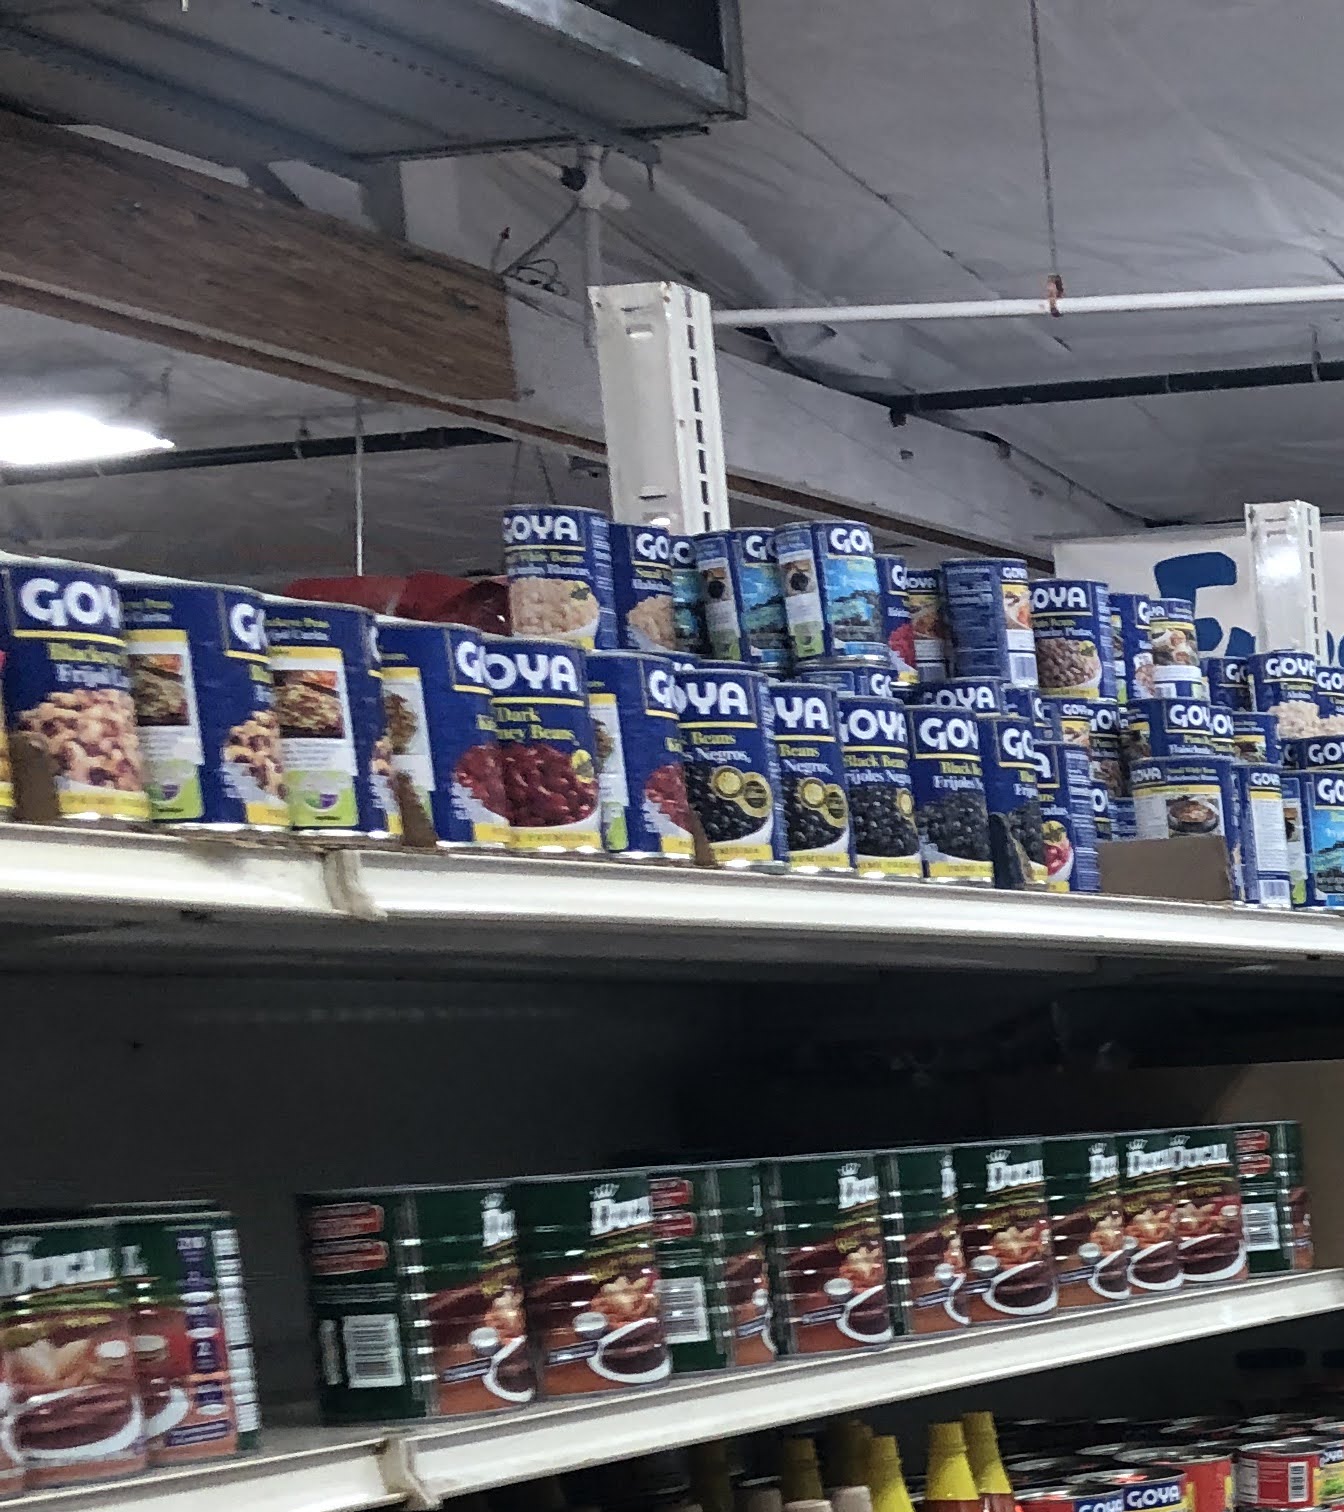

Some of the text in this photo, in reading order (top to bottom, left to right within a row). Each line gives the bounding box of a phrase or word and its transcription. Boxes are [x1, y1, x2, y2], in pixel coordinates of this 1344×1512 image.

[636, 532, 669, 561] GO
[1032, 586, 1087, 609] OYA
[775, 696, 830, 729] YA
[692, 731, 736, 745] Beans
[779, 744, 820, 757] Beans
[1127, 1484, 1181, 1508] GOYA
